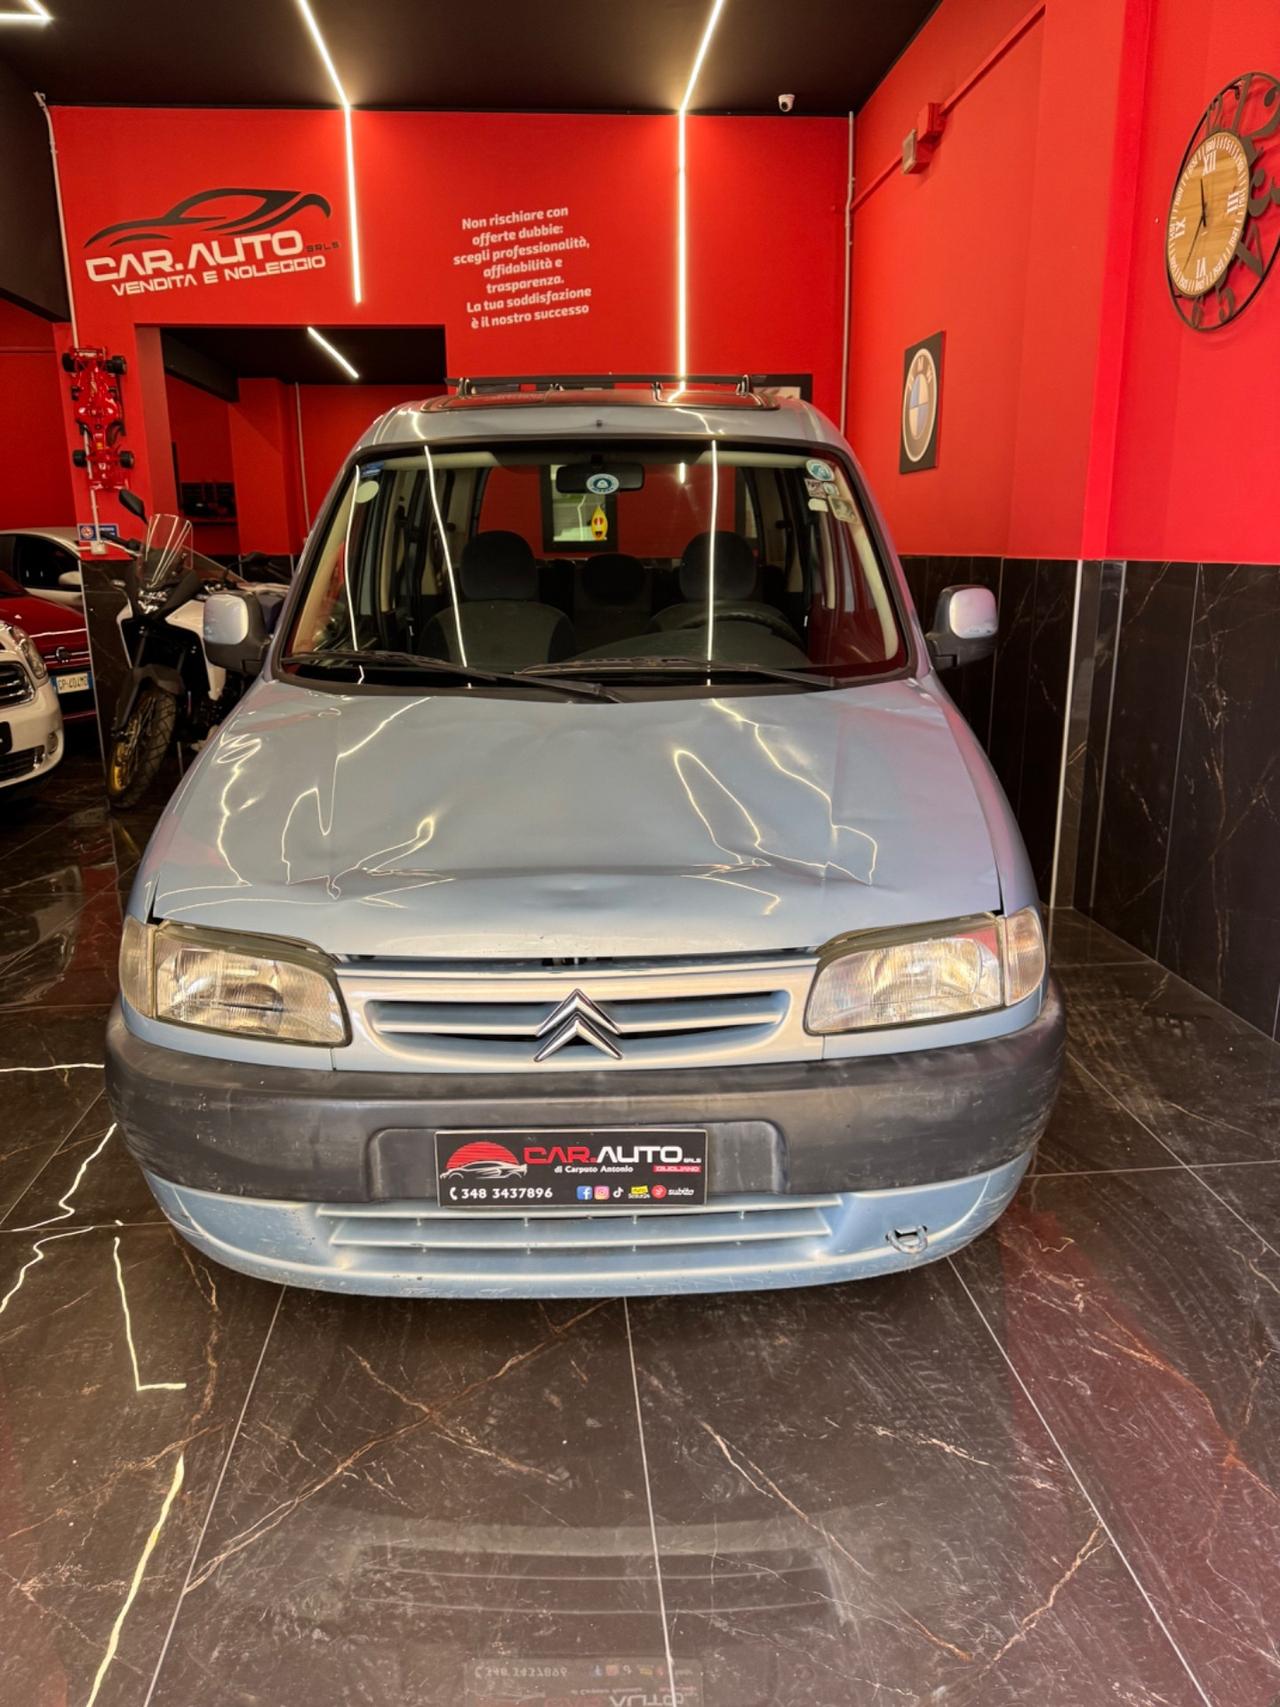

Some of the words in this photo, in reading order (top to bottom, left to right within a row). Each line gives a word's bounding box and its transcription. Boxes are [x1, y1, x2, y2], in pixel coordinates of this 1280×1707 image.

[462, 218, 486, 230] Non
[489, 210, 544, 226] rischiare
[546, 207, 569, 218] con
[472, 230, 516, 247] offerte
[518, 224, 564, 239] dubbie:
[85, 230, 304, 282] CAR.AUTO
[453, 250, 490, 265] scegli
[492, 236, 590, 261] professionalità,
[112, 274, 197, 297] VENDITA
[203, 271, 219, 285] E
[224, 255, 326, 281] NOLEGGIO
[483, 258, 552, 279] affidabilità
[555, 258, 563, 268] e
[486, 275, 564, 294] trasparenza.
[466, 302, 482, 313] La
[484, 298, 504, 311] tua
[506, 287, 592, 308] soddisfazione
[471, 317, 479, 329] è
[481, 316, 490, 328] il
[491, 311, 532, 326] nostro
[534, 304, 589, 321] successo
[523, 1145, 683, 1164] CAR.AUTO
[554, 1165, 563, 1174] di
[600, 1165, 634, 1173] Antonio
[461, 1187, 487, 1199] 348
[492, 1187, 553, 1199] 3437896
